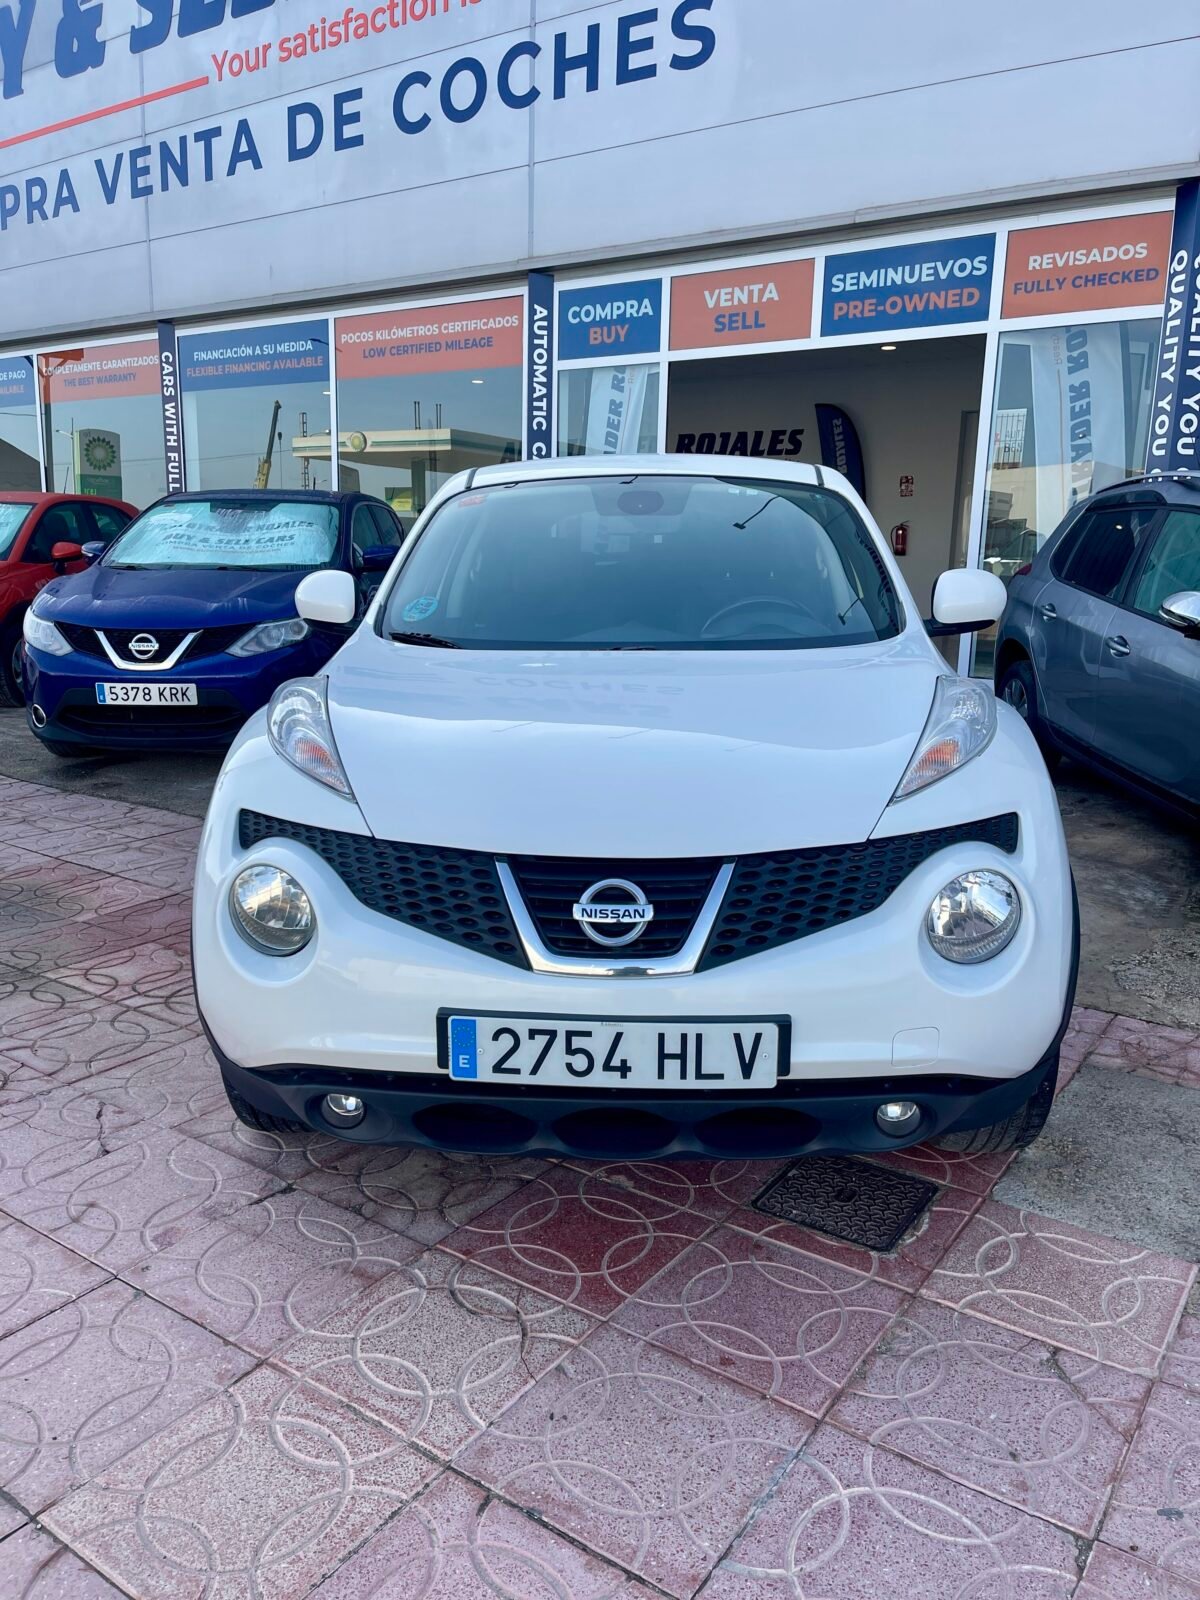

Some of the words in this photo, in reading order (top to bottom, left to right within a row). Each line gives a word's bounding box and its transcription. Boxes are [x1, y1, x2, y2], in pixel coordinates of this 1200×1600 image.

[212, 42, 271, 81] Your
[279, 0, 448, 62] satisfaction
[0, 168, 80, 231] PRA
[95, 118, 263, 205] VENTA
[287, 88, 364, 162] DE
[393, 0, 716, 135] COCHES
[1028, 243, 1148, 271] REVISADOS
[831, 255, 988, 293] SEMINUEVOS
[1013, 277, 1066, 295] FULLY
[1071, 267, 1159, 289] CHECKED
[703, 282, 779, 309] VENTA
[833, 287, 980, 320] PRE-OWNED
[567, 298, 653, 324] COMPRA
[714, 310, 765, 333] SELL
[1161, 249, 1188, 383] QUALITY
[341, 331, 374, 344] POCOS
[375, 324, 439, 341] KILÓMETROS
[441, 315, 519, 334] CERTIFICADOS
[589, 324, 629, 345] BUY
[193, 344, 253, 362] FINANCIACIÓN
[254, 345, 262, 356] A
[263, 344, 275, 355] SU
[276, 340, 313, 354] MEDIDA
[363, 346, 387, 358] LOW
[389, 341, 442, 356] CERTIFIED
[445, 336, 493, 351] MILEAGE
[102, 355, 159, 370] GARANTIZADOS
[161, 352, 175, 396] CARS
[186, 363, 223, 377] FLEXIBLE
[224, 360, 271, 374] FINANCING
[272, 356, 324, 369] AVAILABLE
[533, 304, 548, 431] AUTOMATIC
[63, 378, 77, 387] THE
[78, 376, 95, 387] BEST
[96, 372, 137, 385] WARRANTY
[165, 402, 178, 446] WITH
[603, 399, 623, 454] DER
[1152, 393, 1172, 456] YOU
[1177, 392, 1200, 455] YOU
[531, 442, 546, 459] C
[675, 429, 805, 456] ROJALES
[168, 453, 180, 492] FULL
[256, 534, 296, 544] CARS
[109, 686, 152, 702] 5378
[158, 686, 191, 702] KRK
[580, 907, 646, 920] NISSAN
[459, 1055, 470, 1068] E
[491, 1026, 632, 1079] 2754
[657, 1032, 763, 1081] HLV
